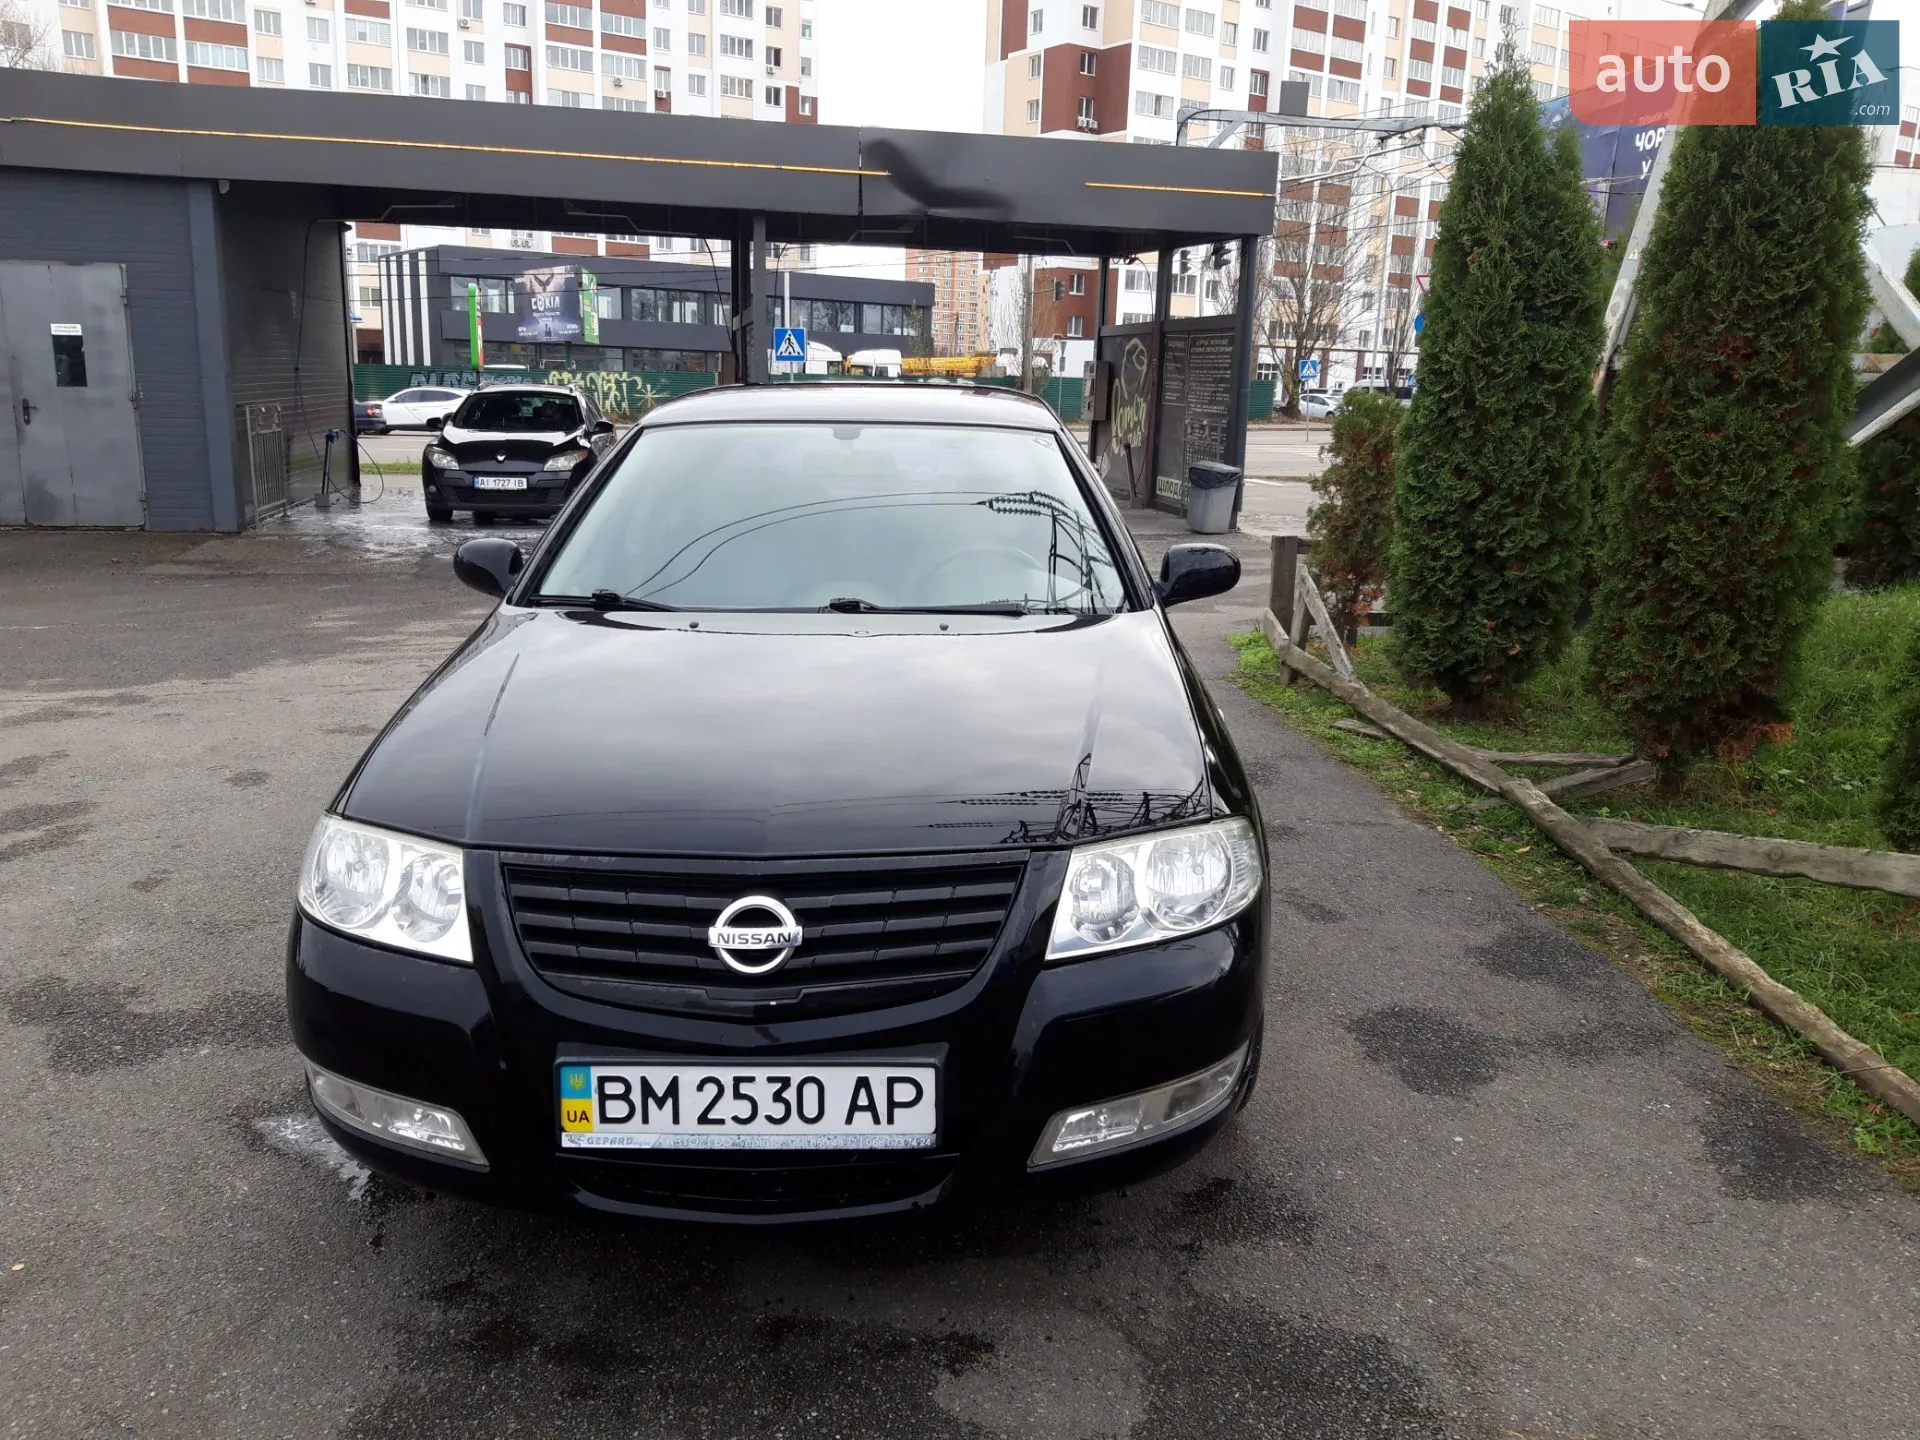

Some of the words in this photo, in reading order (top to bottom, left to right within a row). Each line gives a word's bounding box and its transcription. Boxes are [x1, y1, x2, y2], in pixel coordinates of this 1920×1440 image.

[493, 478, 511, 488] 1727
[717, 932, 792, 945] NISSAN
[596, 1075, 680, 1125] BM
[696, 1075, 825, 1125] 2530
[845, 1075, 924, 1125] AP
[566, 1109, 591, 1124] UA
